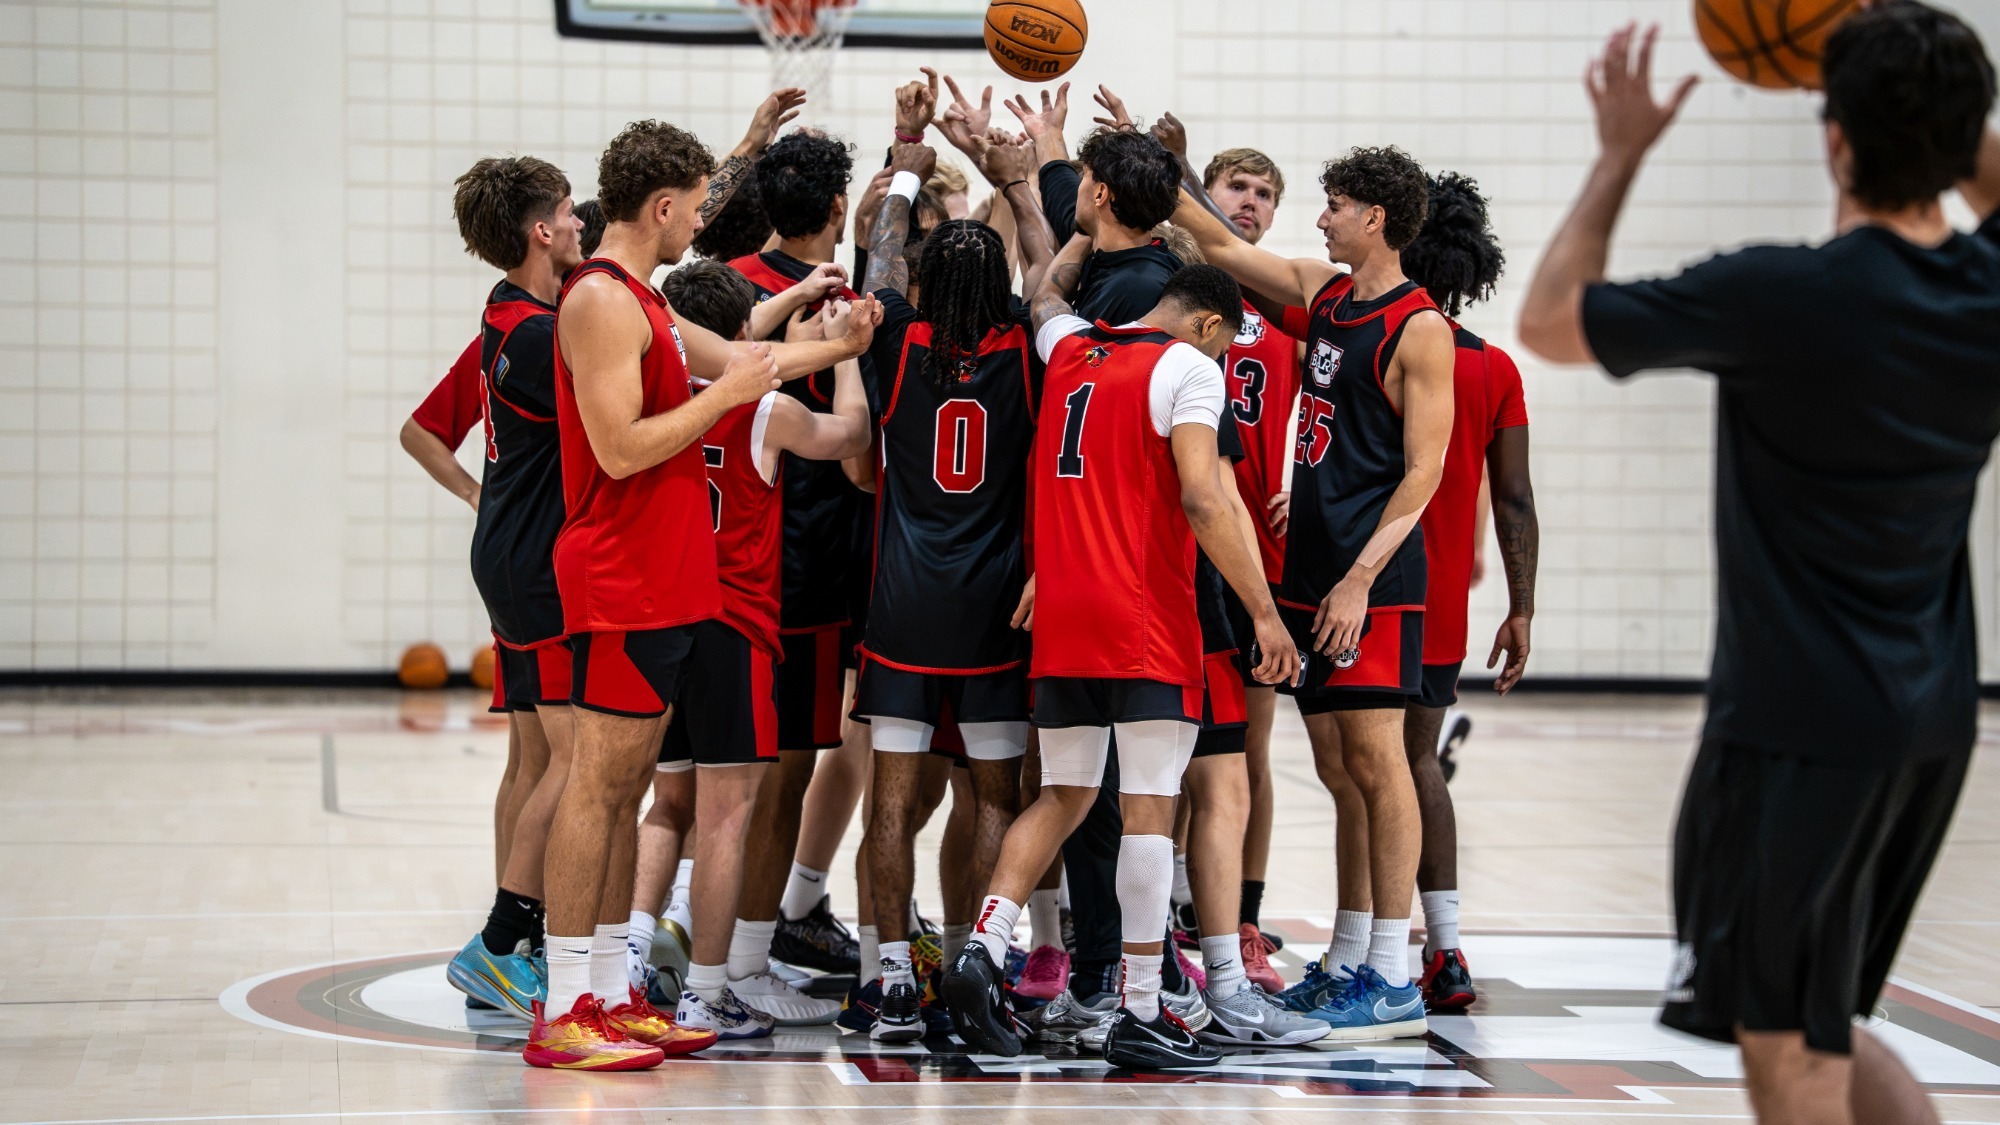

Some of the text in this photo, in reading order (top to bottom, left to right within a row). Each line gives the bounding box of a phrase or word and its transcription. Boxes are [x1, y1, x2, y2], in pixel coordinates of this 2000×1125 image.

[994, 38, 1061, 74] Wilson
[1010, 15, 1062, 45] NCAA
[1311, 353, 1339, 376] BARY
[933, 398, 987, 493] 0
[1056, 382, 1096, 478] 1
[1294, 391, 1336, 468] 25
